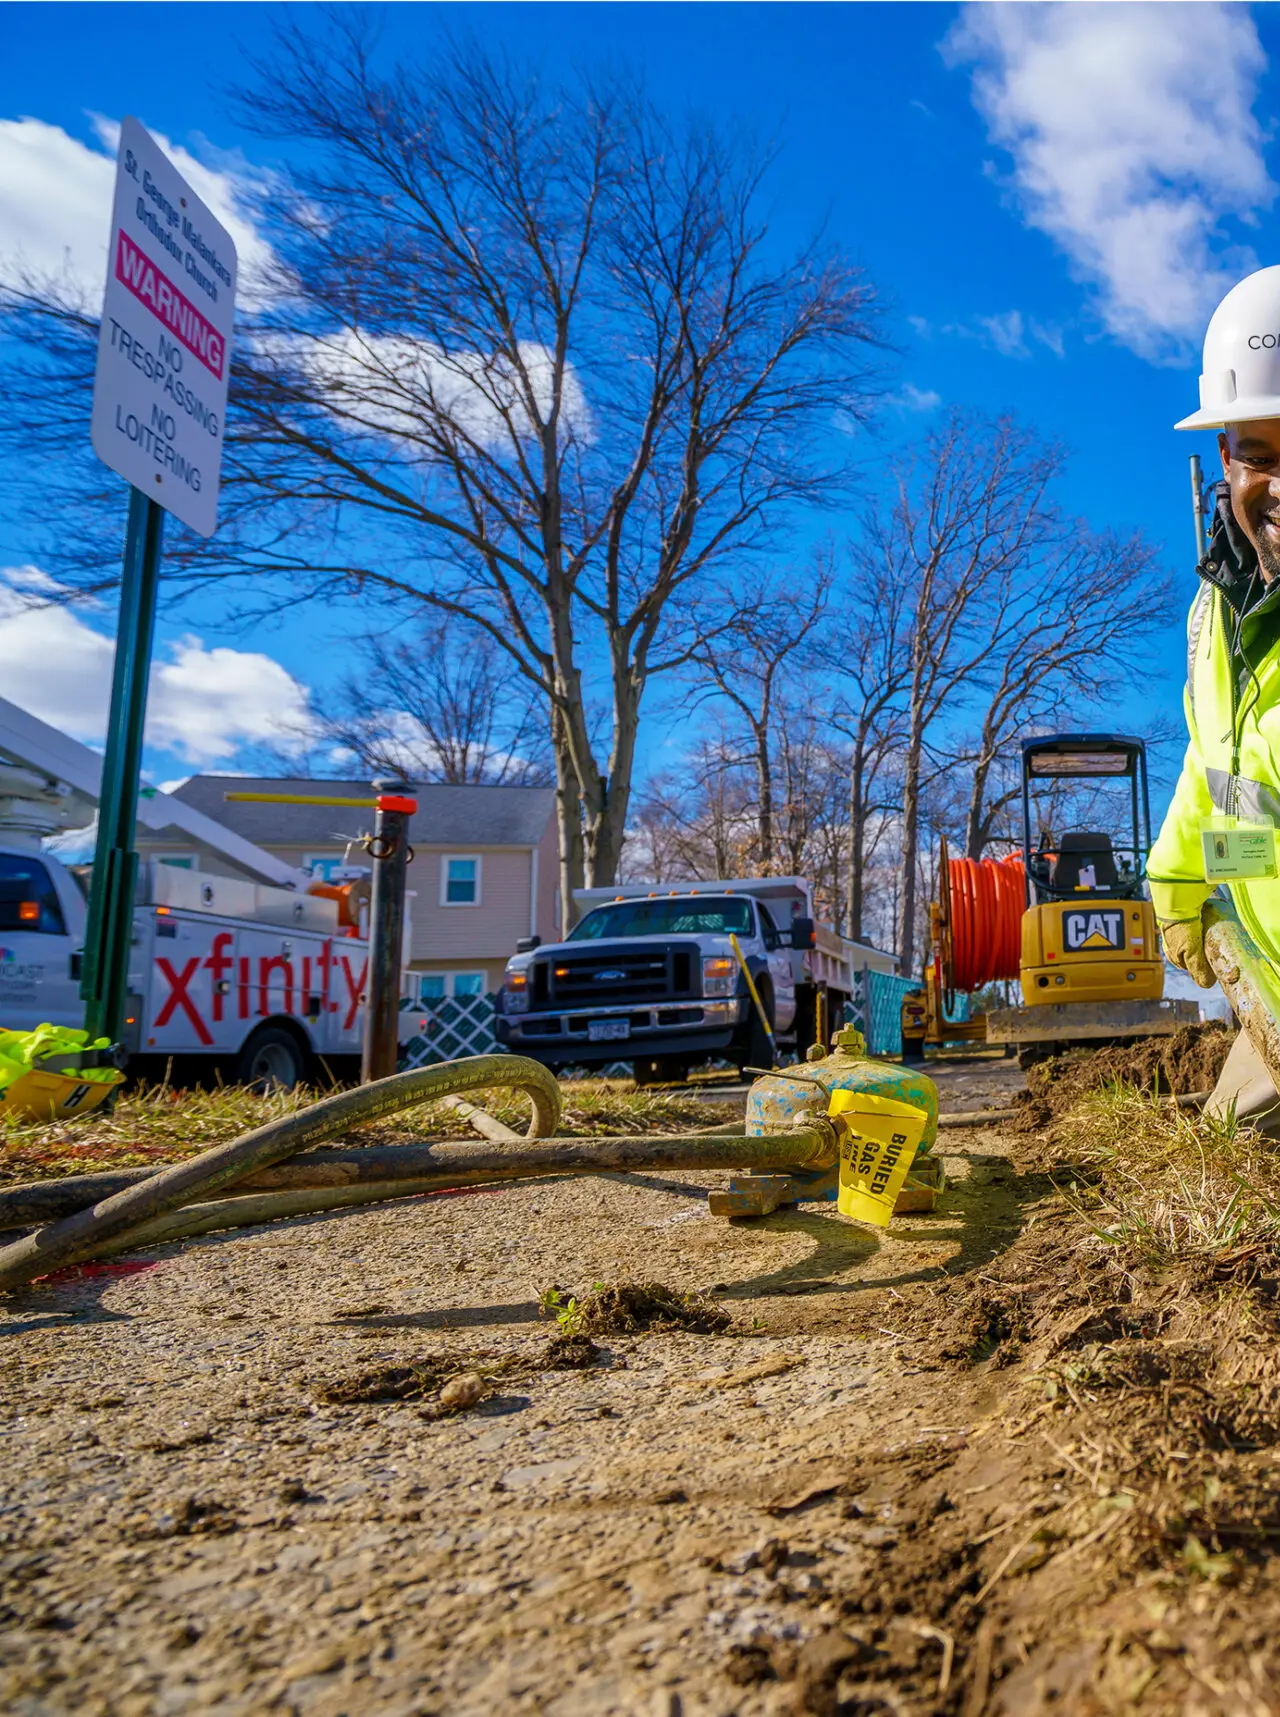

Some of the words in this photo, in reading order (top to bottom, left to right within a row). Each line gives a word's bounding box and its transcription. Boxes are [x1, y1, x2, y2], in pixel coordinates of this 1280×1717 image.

[125, 149, 140, 183] St.
[143, 169, 180, 228] George
[182, 216, 231, 287] Malankara
[136, 196, 183, 265] Orthodox
[185, 252, 218, 303] Church
[121, 239, 221, 371] WARNING
[109, 317, 218, 437] TRESPASSING
[158, 334, 183, 373] NO
[115, 404, 202, 492] LOITERING
[151, 403, 176, 441] NO
[1067, 914, 1120, 948] CAT
[152, 932, 370, 1046] xfinity
[858, 1141, 881, 1175] GAS
[870, 1132, 907, 1195] BURIED
